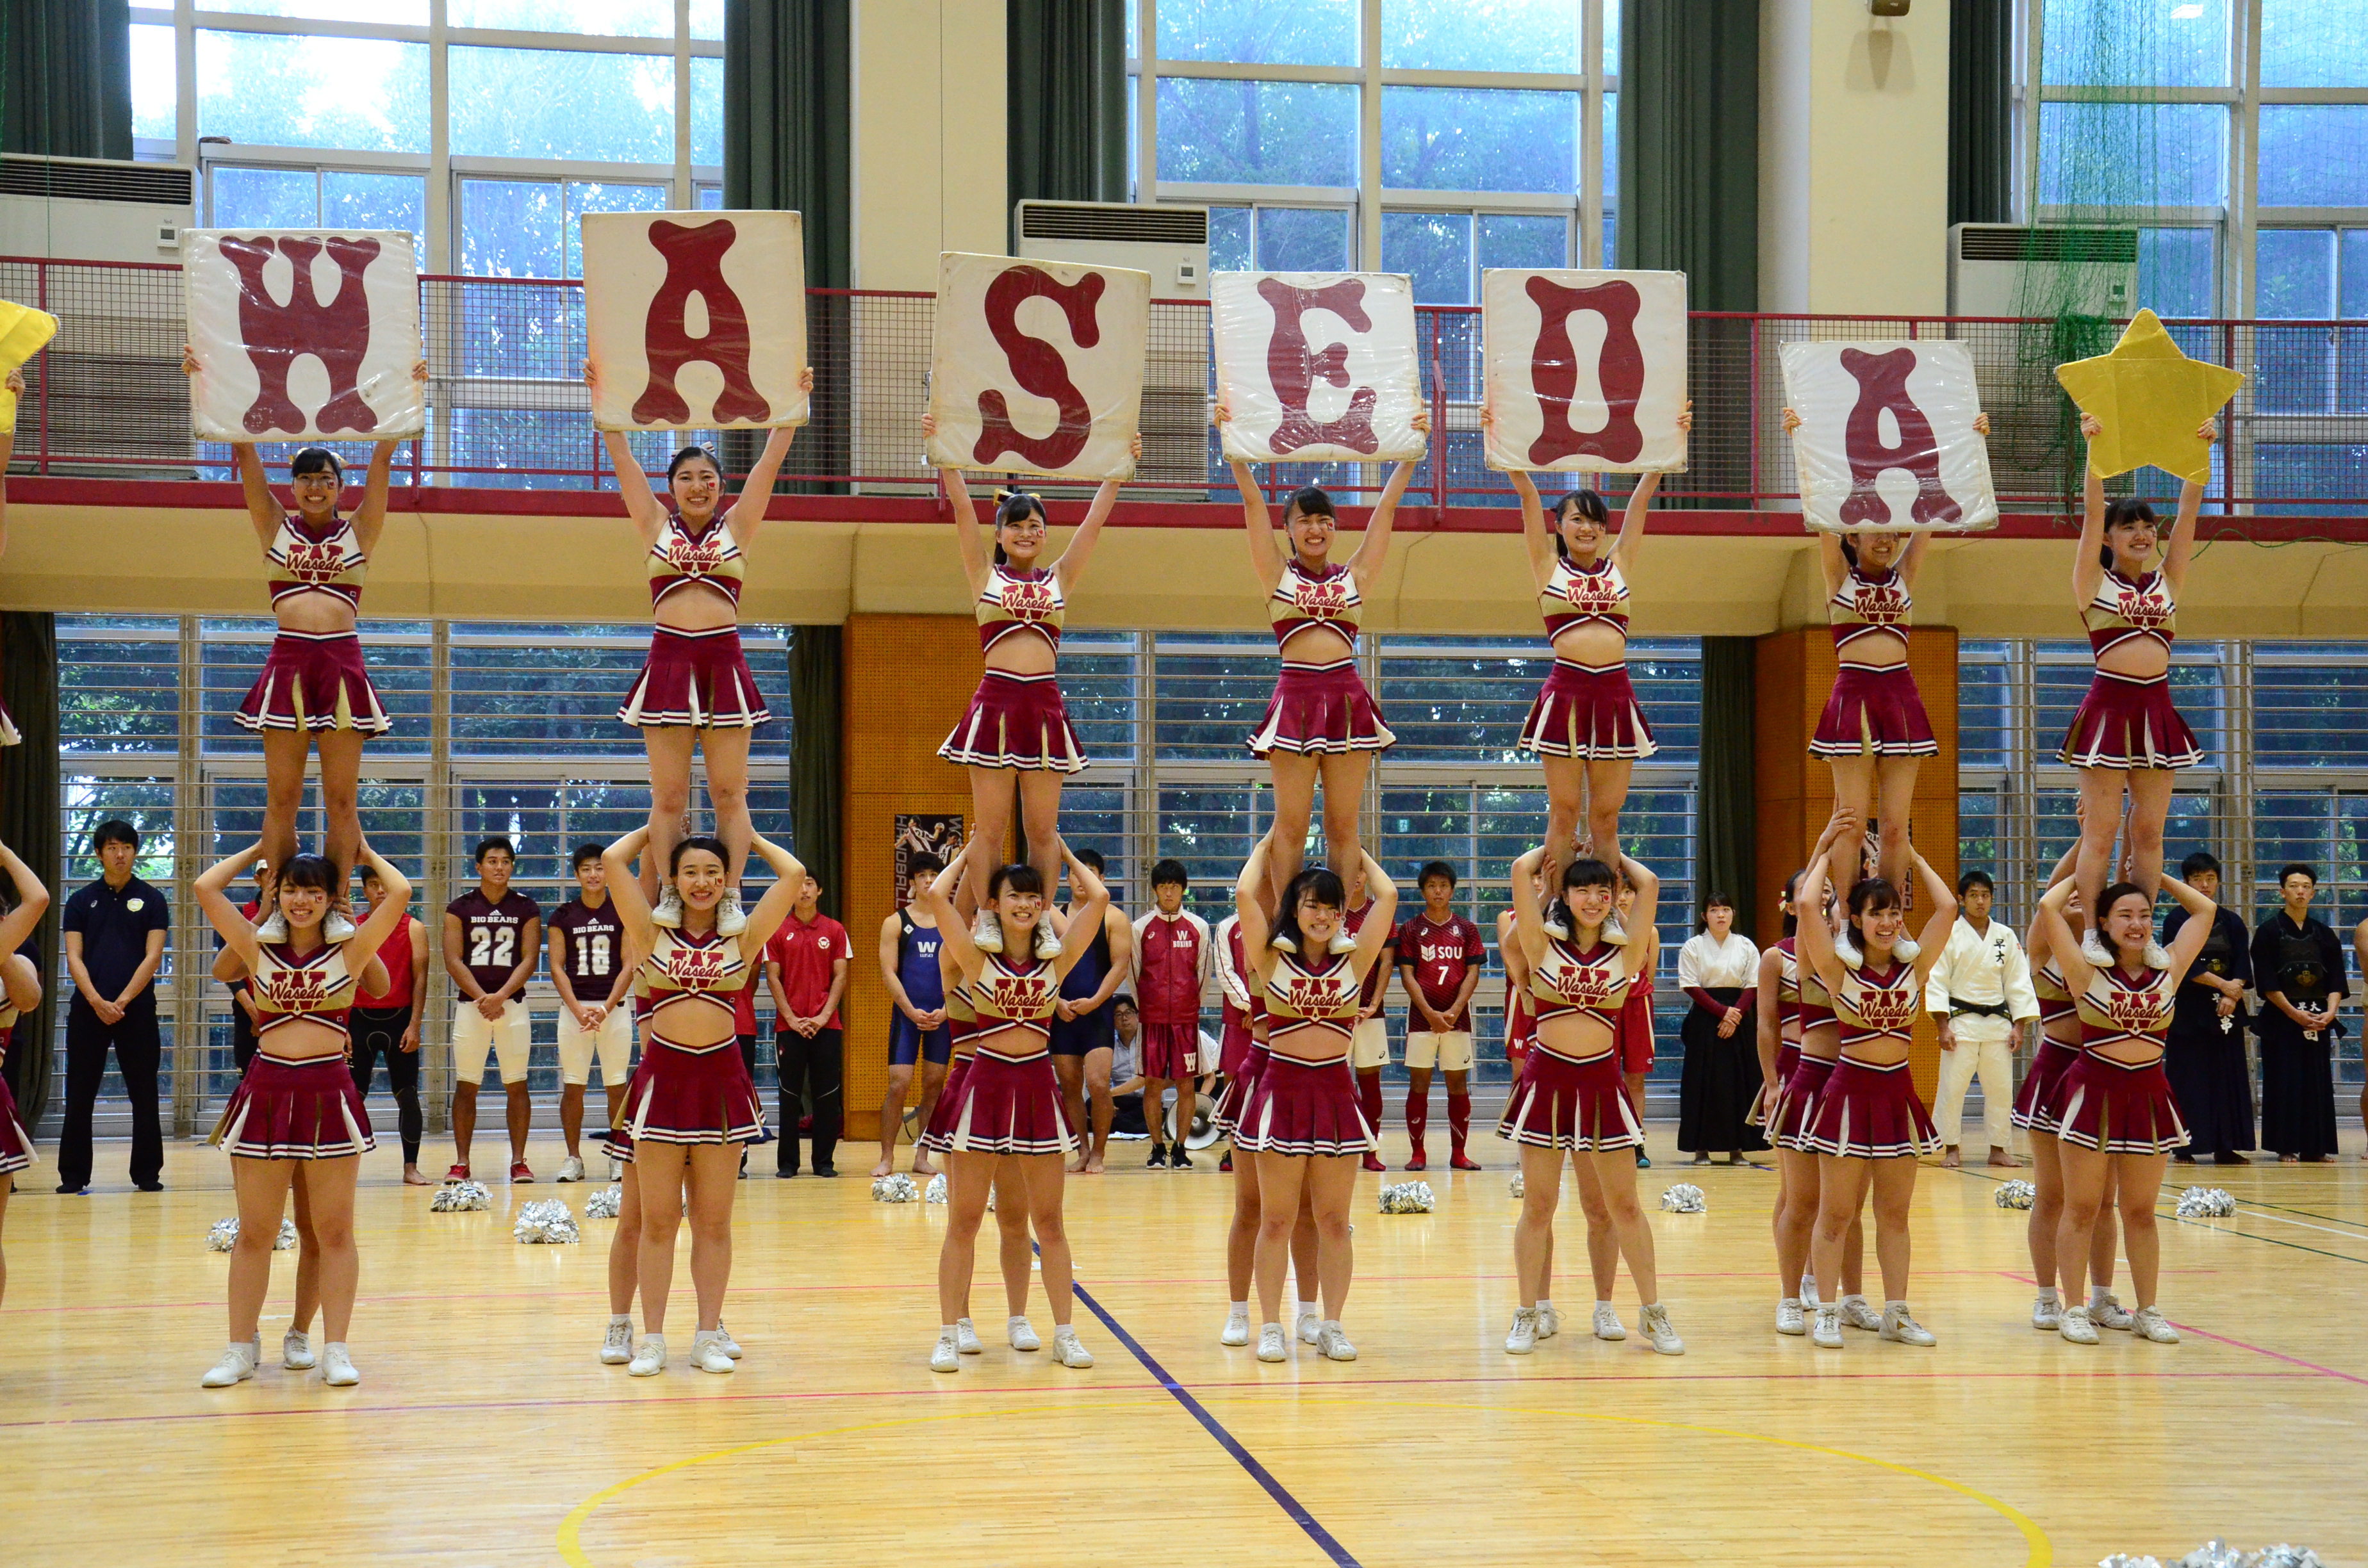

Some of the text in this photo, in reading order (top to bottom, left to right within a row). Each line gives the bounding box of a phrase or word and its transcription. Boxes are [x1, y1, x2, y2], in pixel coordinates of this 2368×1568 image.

[631, 218, 771, 425] A
[218, 236, 381, 434] W
[973, 265, 1106, 470] S
[1257, 278, 1379, 455] E
[1525, 275, 1645, 466] D
[1839, 347, 1963, 526] A
[287, 554, 344, 572] Waseda
[670, 547, 722, 562] Waseda
[1002, 593, 1054, 610] Waseda
[1295, 592, 1347, 608] Waseda
[1566, 587, 1619, 602] Waseda
[1854, 598, 1905, 613] Waseda
[2118, 601, 2169, 617] Waseda
[1177, 931, 1188, 940] W
[470, 926, 515, 967] 22
[575, 934, 611, 975] 18
[917, 942, 937, 953] W
[1438, 946, 1462, 960] SOU
[1994, 939, 2005, 965] 早大
[668, 960, 723, 978] Waseda
[1438, 966, 1449, 985] 7
[269, 983, 326, 1000] Waseda
[1558, 976, 1610, 997] Waseda
[994, 990, 1046, 1006] Waseda
[1289, 989, 1343, 1008] Waseda
[1859, 1001, 1910, 1018] Waseda
[2109, 1002, 2162, 1019] Waseda
[1513, 1038, 1524, 1049] W
[1183, 1052, 1196, 1072] W
